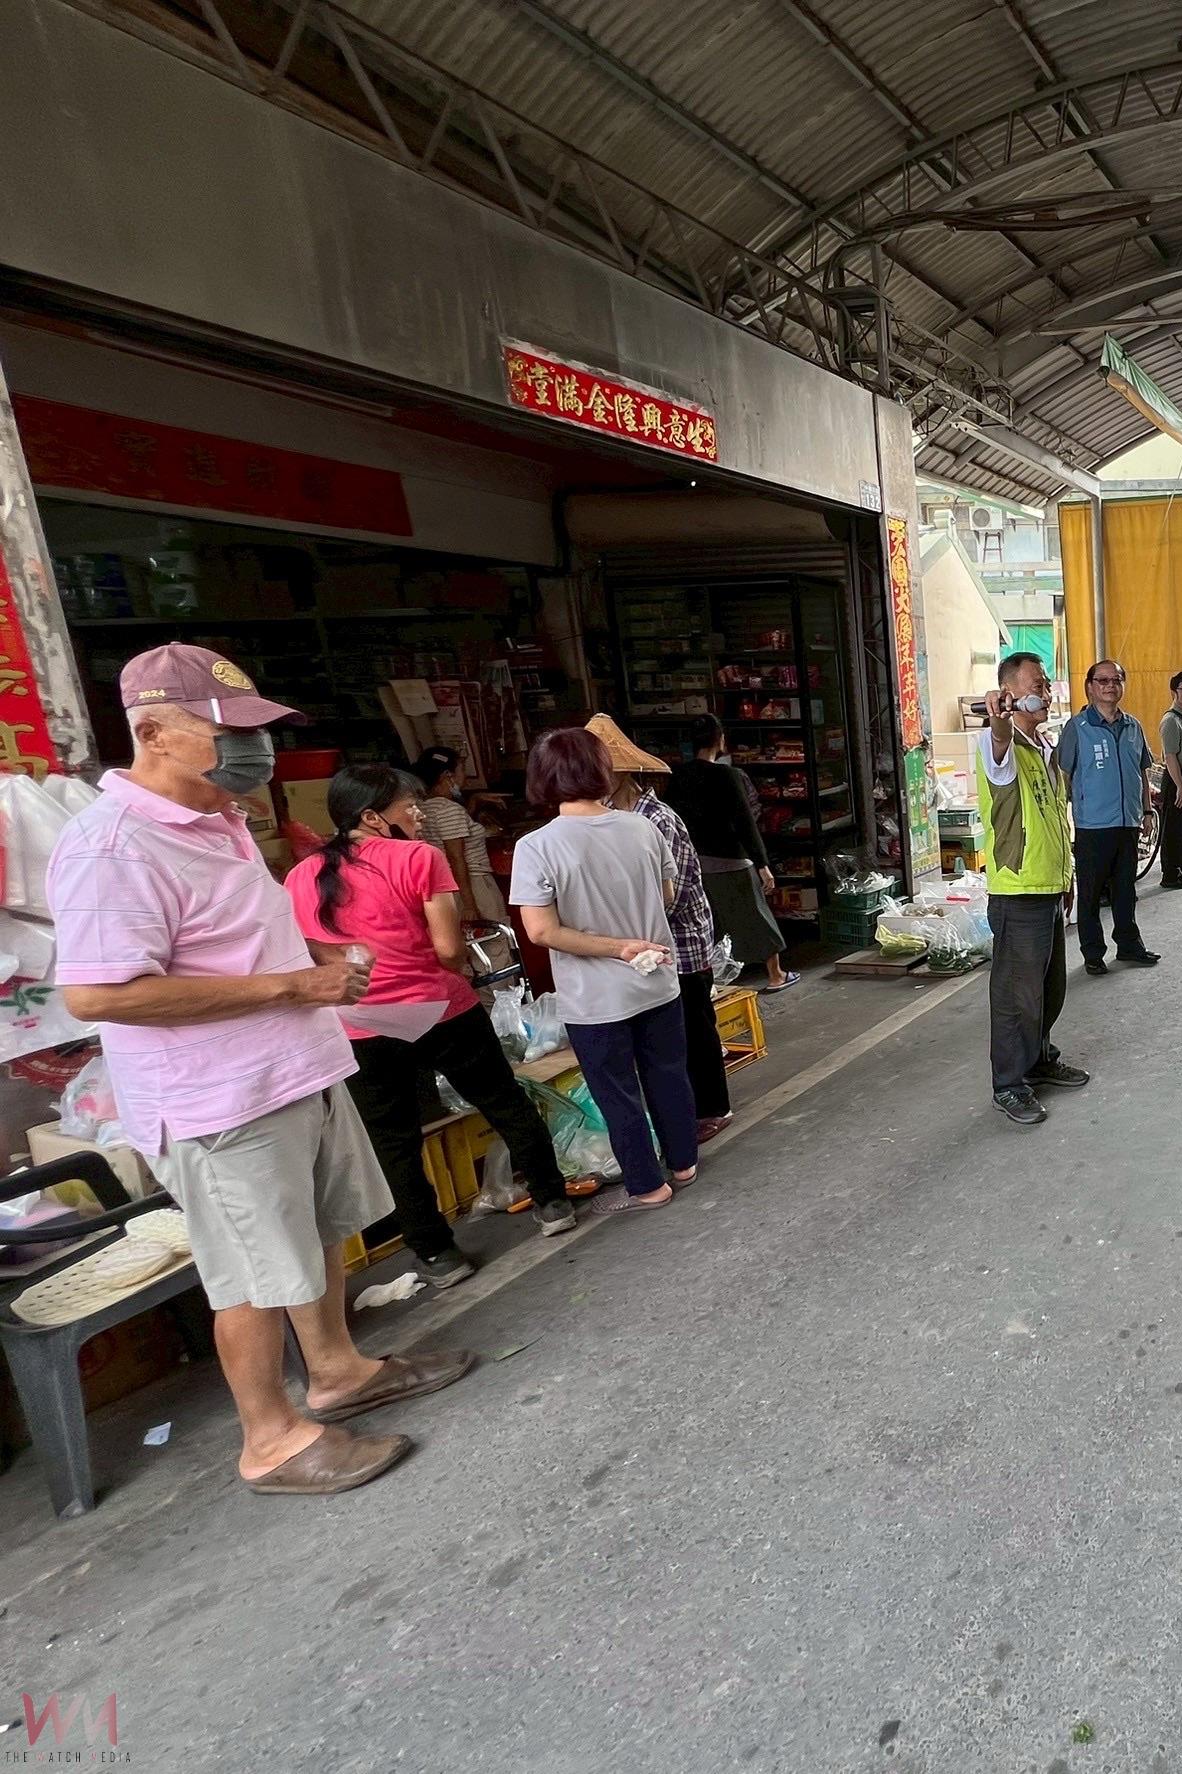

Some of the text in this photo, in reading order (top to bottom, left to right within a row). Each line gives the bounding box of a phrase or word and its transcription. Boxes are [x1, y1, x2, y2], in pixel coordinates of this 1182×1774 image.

[526, 361, 709, 454] 生意興隆金滿堂
[138, 688, 167, 700] 2024
